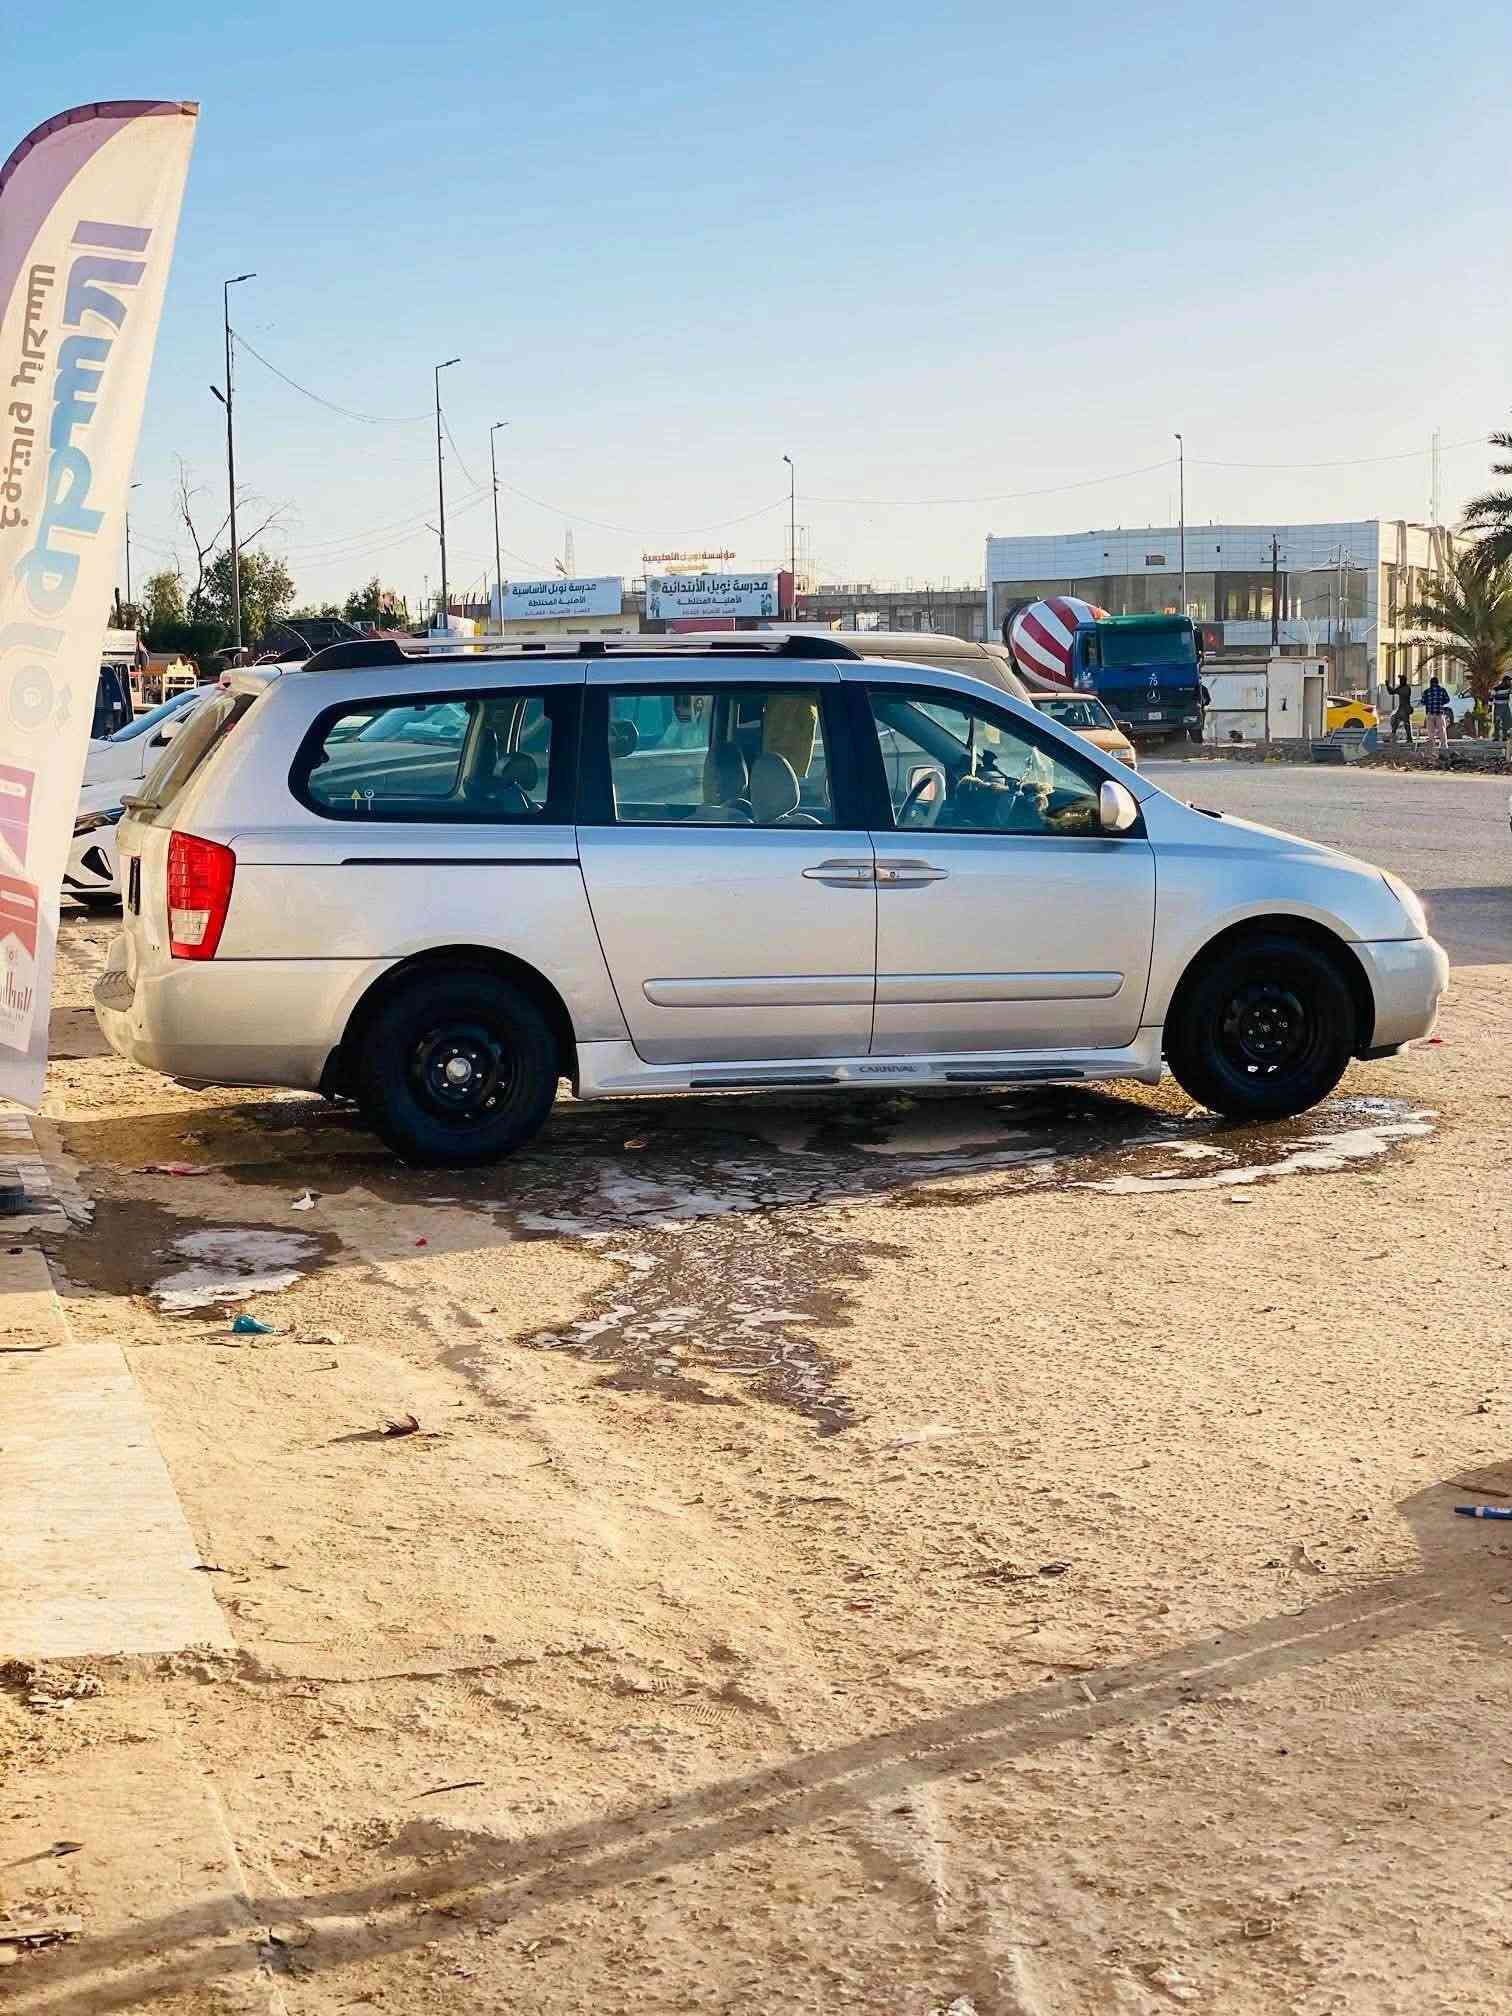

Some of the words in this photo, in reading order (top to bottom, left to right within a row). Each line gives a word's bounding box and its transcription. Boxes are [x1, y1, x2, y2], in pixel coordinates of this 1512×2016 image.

[702, 550, 736, 561] مؤسسة
[547, 584, 567, 595] نوبل
[568, 583, 597, 595] مدرسة
[707, 579, 730, 595] نوبل
[733, 579, 768, 593] مدرسة
[858, 1063, 918, 1073] CARNIVAL
